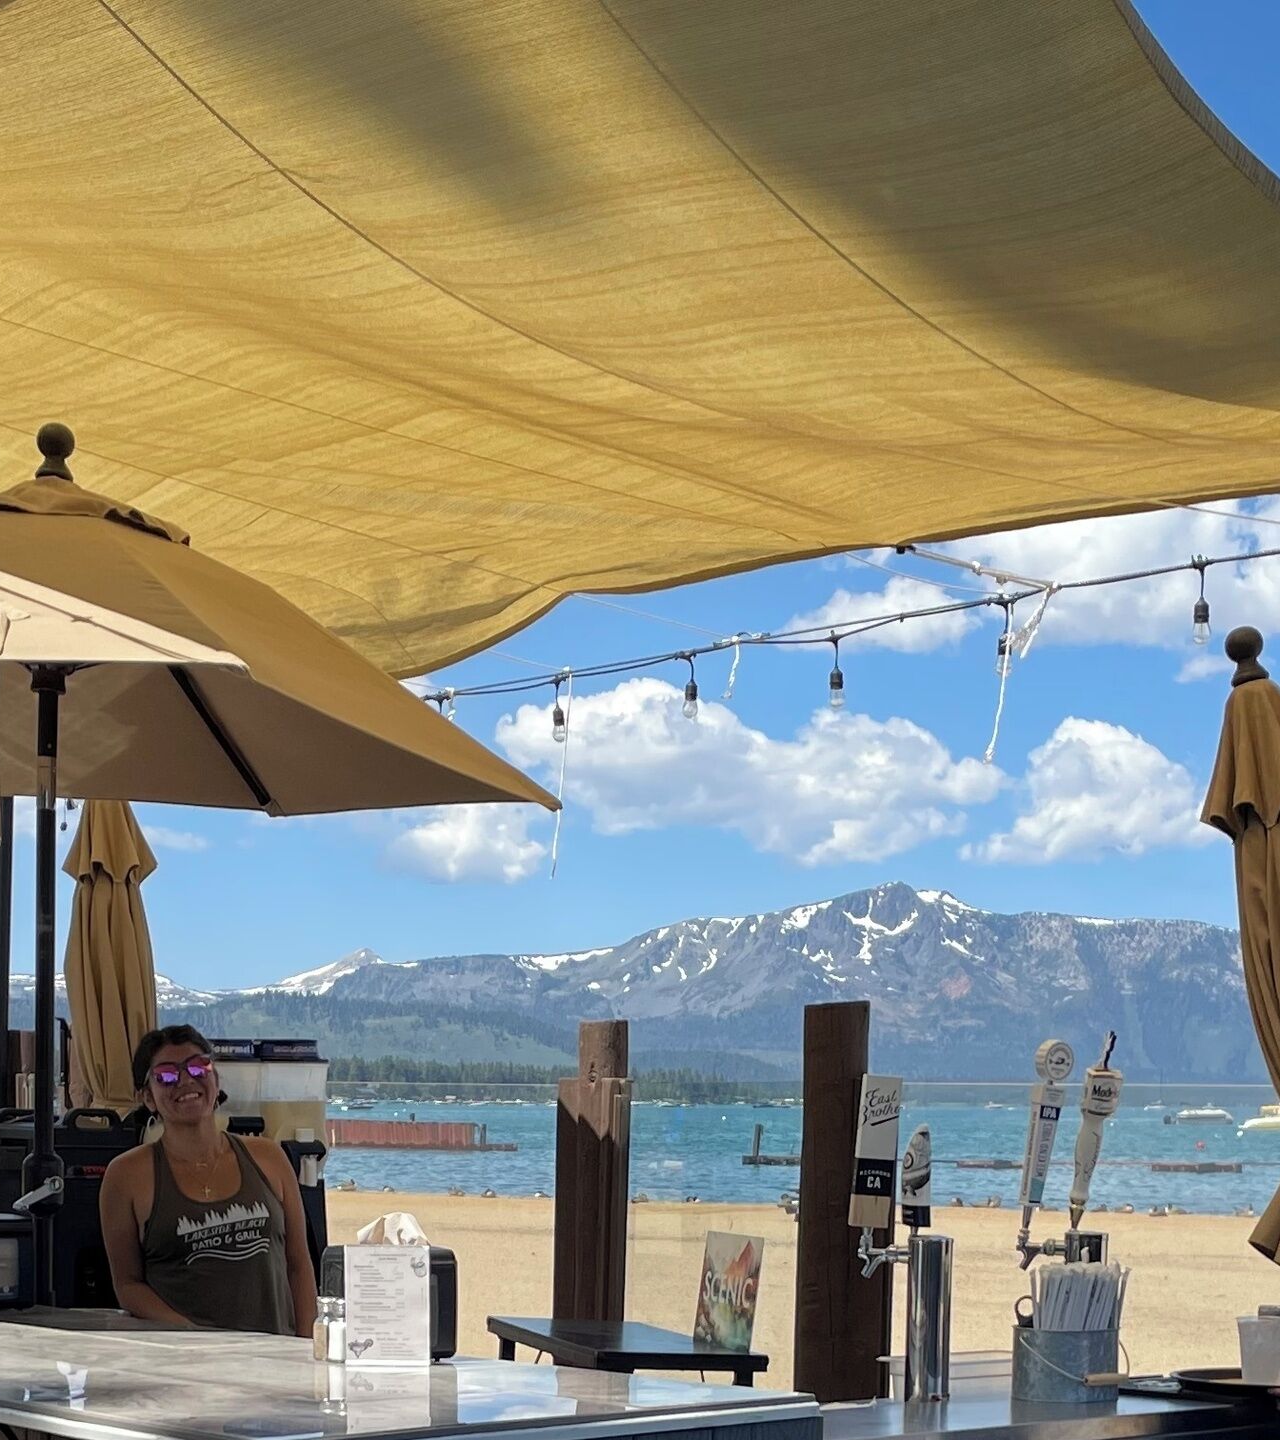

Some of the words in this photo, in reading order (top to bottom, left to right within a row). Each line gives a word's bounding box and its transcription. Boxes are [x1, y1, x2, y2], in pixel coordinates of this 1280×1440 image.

[865, 1088, 897, 1107] East
[1041, 1107, 1057, 1119] IPA
[866, 1176, 881, 1189] CA
[184, 1223, 231, 1243] LAKESIDE
[235, 1218, 267, 1231] BEACH
[192, 1237, 222, 1251] PATIO
[235, 1230, 262, 1242] GRILL
[702, 1270, 754, 1308] SCENIC
